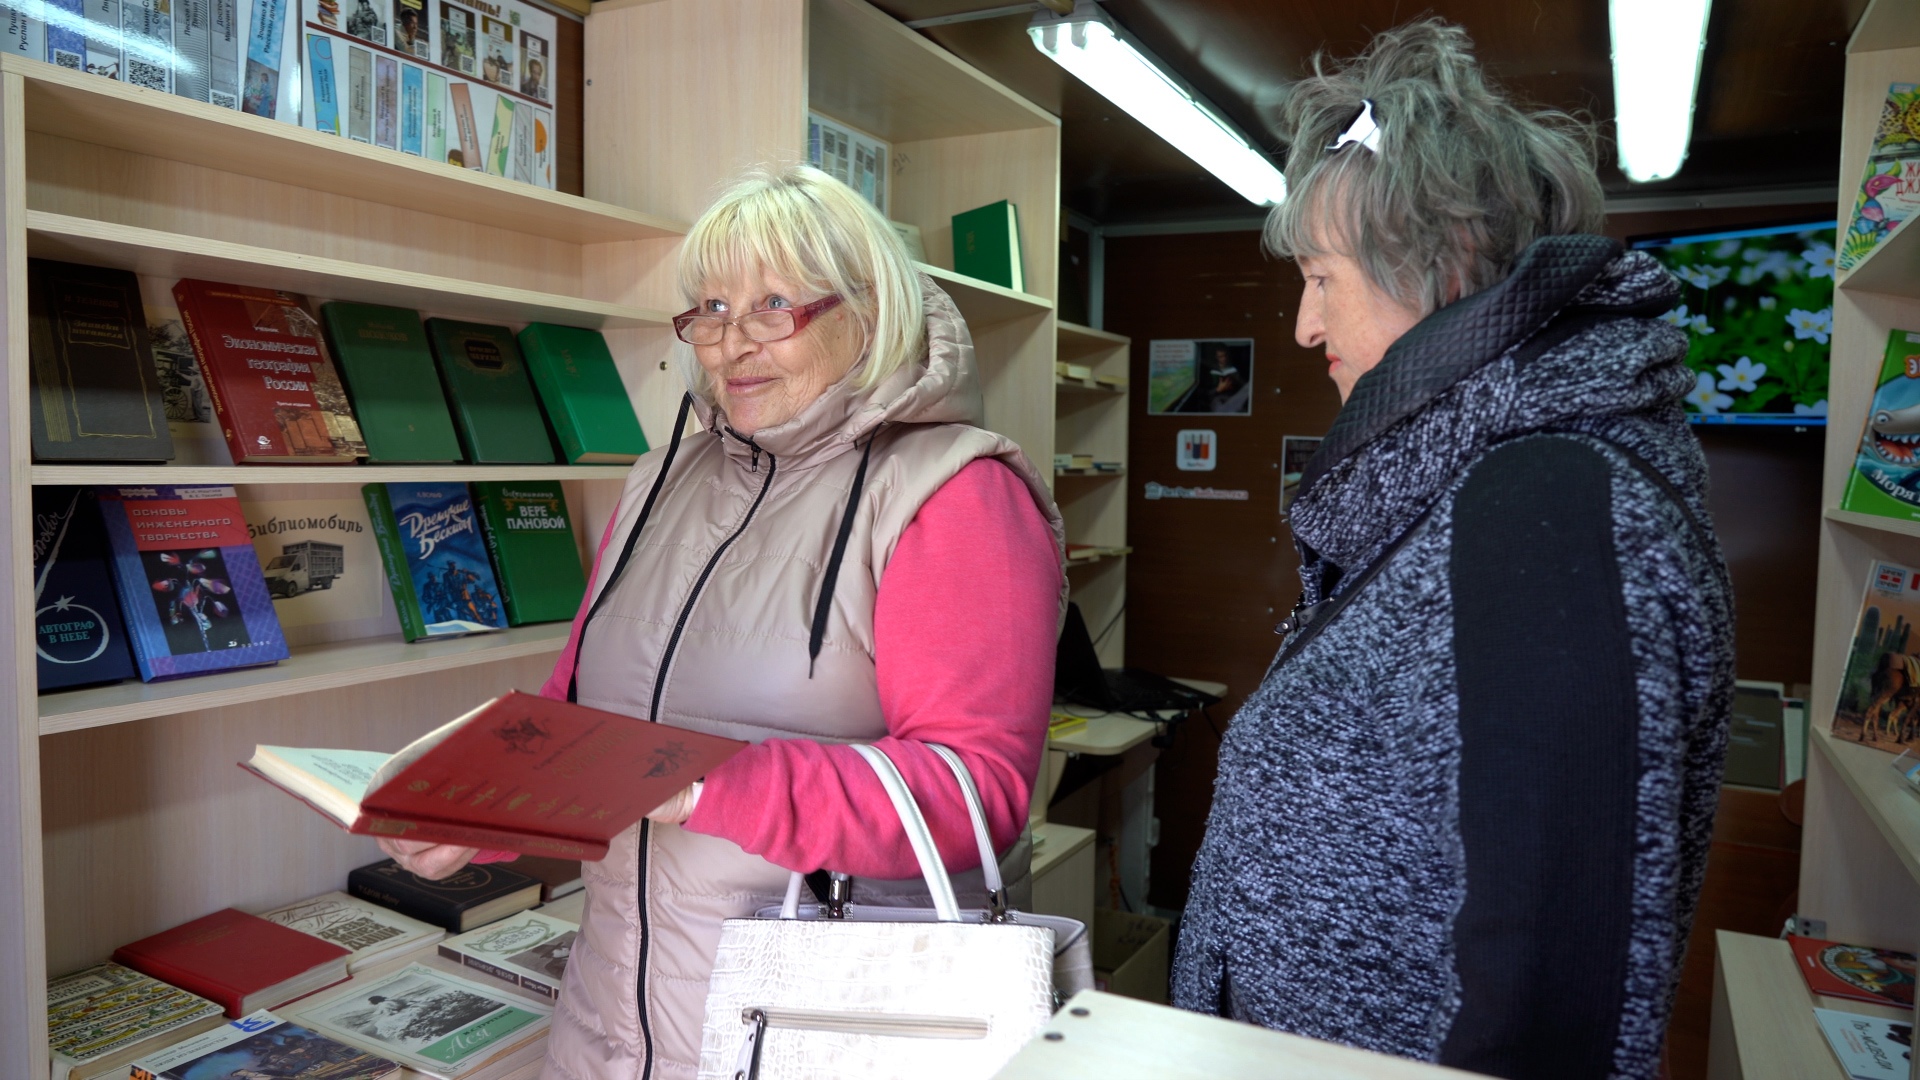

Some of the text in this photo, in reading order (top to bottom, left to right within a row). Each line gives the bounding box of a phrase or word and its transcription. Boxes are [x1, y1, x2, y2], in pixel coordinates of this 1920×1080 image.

[19, 17, 29, 51] Руслан
[224, 9, 232, 42] Мальчик
[256, 9, 267, 41] Зощенко
[264, 5, 277, 54] Рассказы для
[72, 328, 123, 339] писателя
[73, 319, 119, 331] Записки
[222, 334, 318, 356] Экономическая
[246, 358, 311, 376] география
[263, 375, 310, 392] России
[1870, 467, 1916, 503] Моря
[132, 508, 187, 517] ОСНОВЫ
[399, 499, 470, 539] Дремучие
[519, 505, 548, 517] ВЕРЕ
[136, 518, 232, 529] ИНЖЕНЕРНОГО
[506, 516, 566, 530] ПАНОВОЙ
[139, 531, 219, 542] ТВОРЧЕСТВА
[416, 515, 474, 560] Бескиды
[38, 620, 96, 635] АВТОГРАФ
[48, 630, 91, 644] В НЕБЕ
[345, 926, 407, 951] ДУШИ
[445, 1028, 491, 1060] Ася
